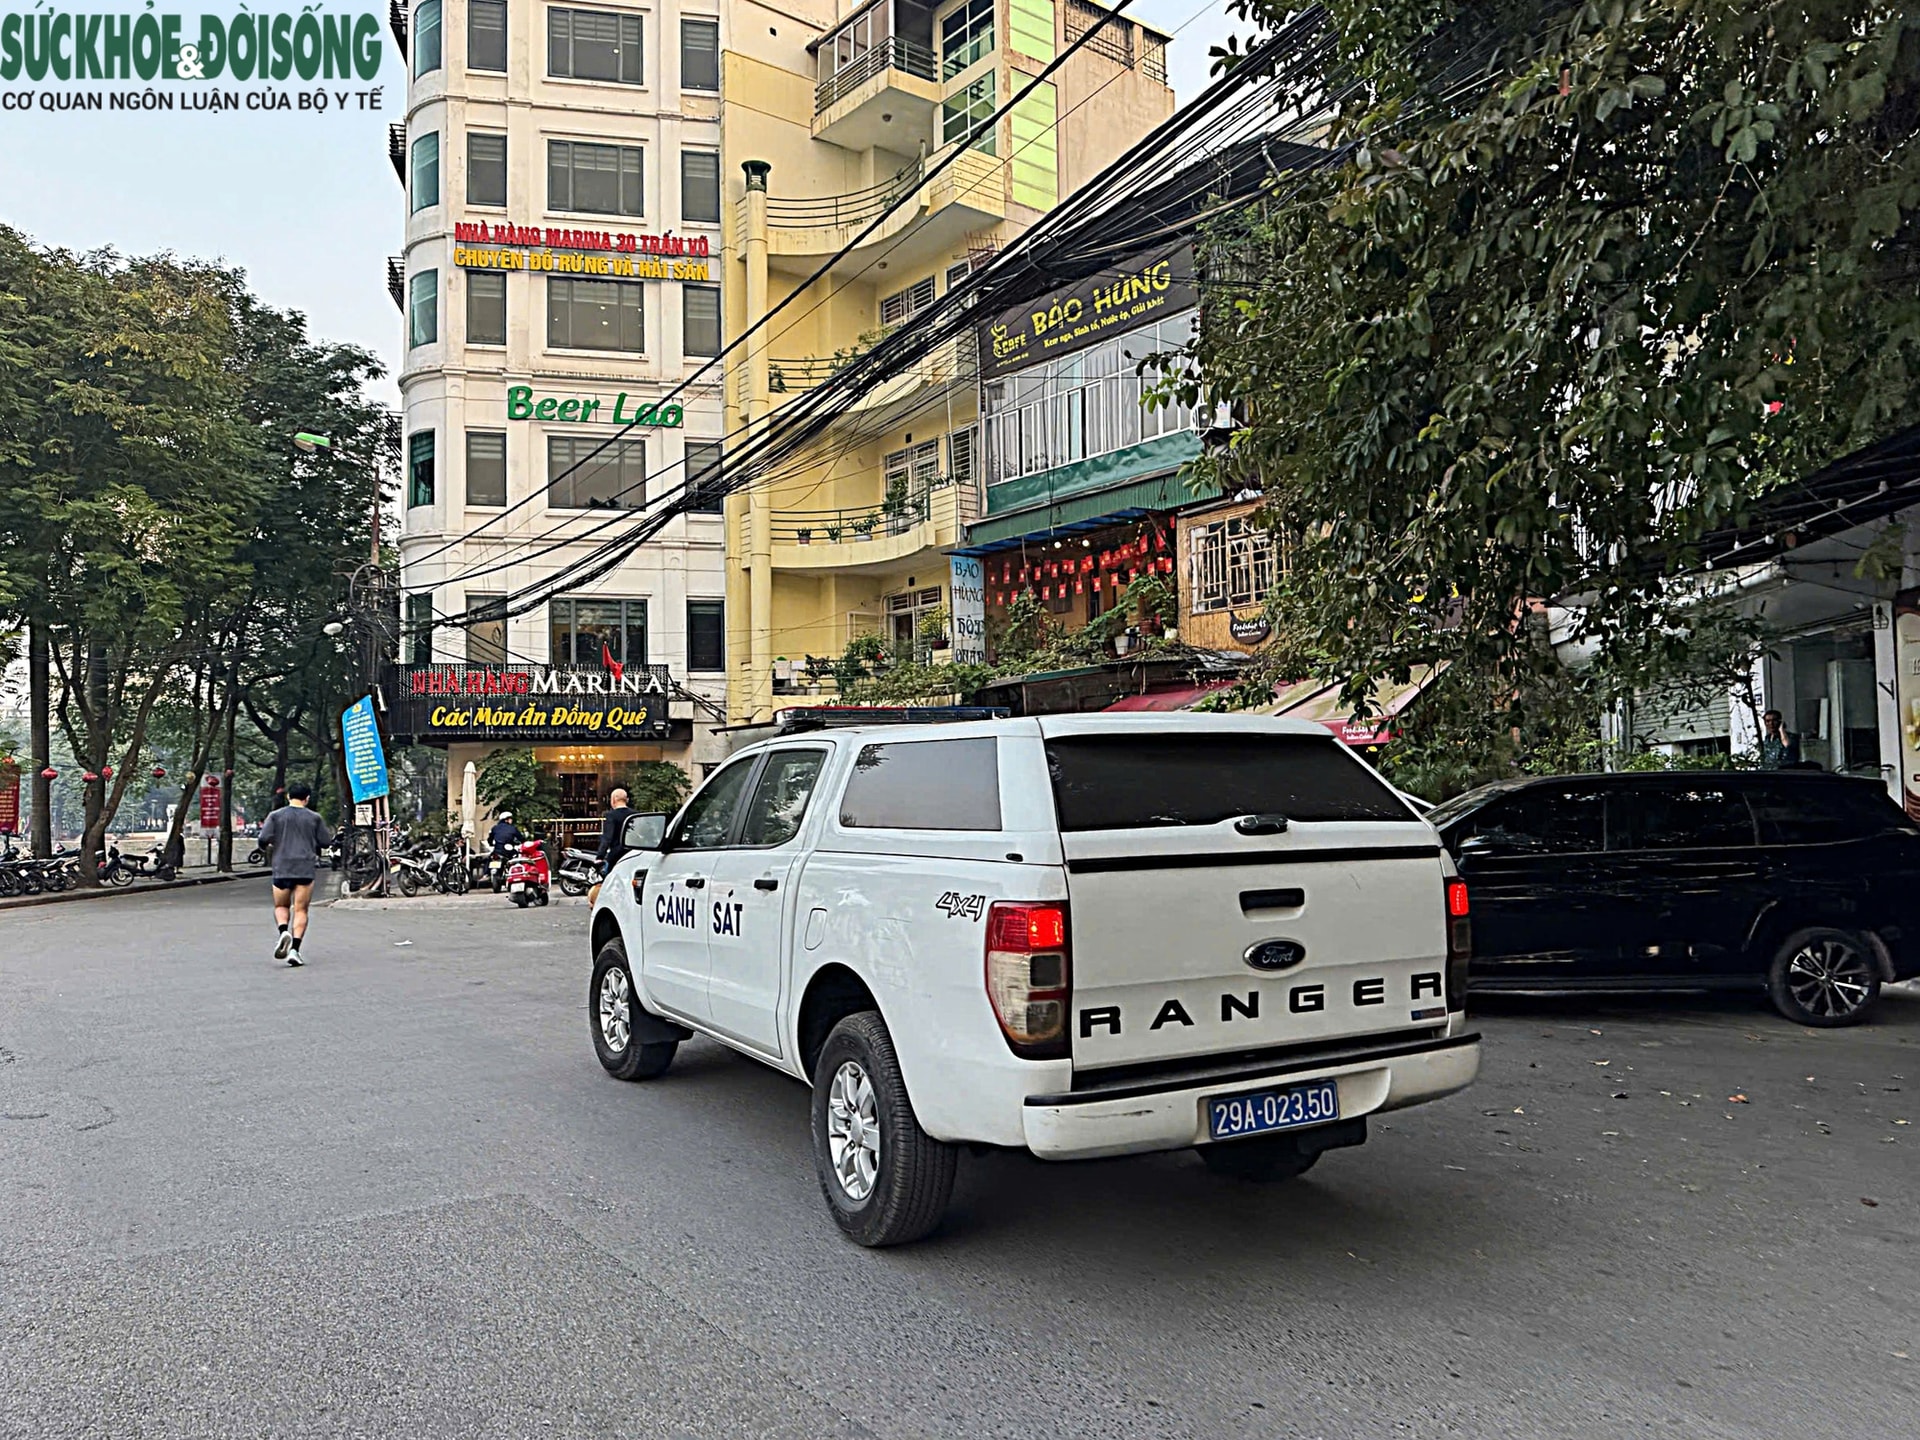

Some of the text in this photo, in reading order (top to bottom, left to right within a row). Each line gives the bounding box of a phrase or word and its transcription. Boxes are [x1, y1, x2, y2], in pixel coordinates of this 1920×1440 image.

[455, 220, 490, 243] NHÀ
[494, 221, 541, 246] HÀNG
[546, 228, 611, 251] MARINA
[616, 233, 636, 253] 30
[454, 247, 708, 281] CHUYÊN ĐỒ RỪNG VÀ HẢI SẢN
[507, 385, 684, 427] Beer Lao
[412, 665, 665, 694] NHÀ HÀNG MARINA
[431, 702, 648, 731] Các Món Ăn Đồng Quê
[656, 882, 743, 937] CẢNH SÁT
[935, 891, 986, 922] 4x4
[1262, 946, 1295, 964] Ford
[1080, 972, 1442, 1038] RANGER
[1215, 1087, 1335, 1135] 29A-023.50
